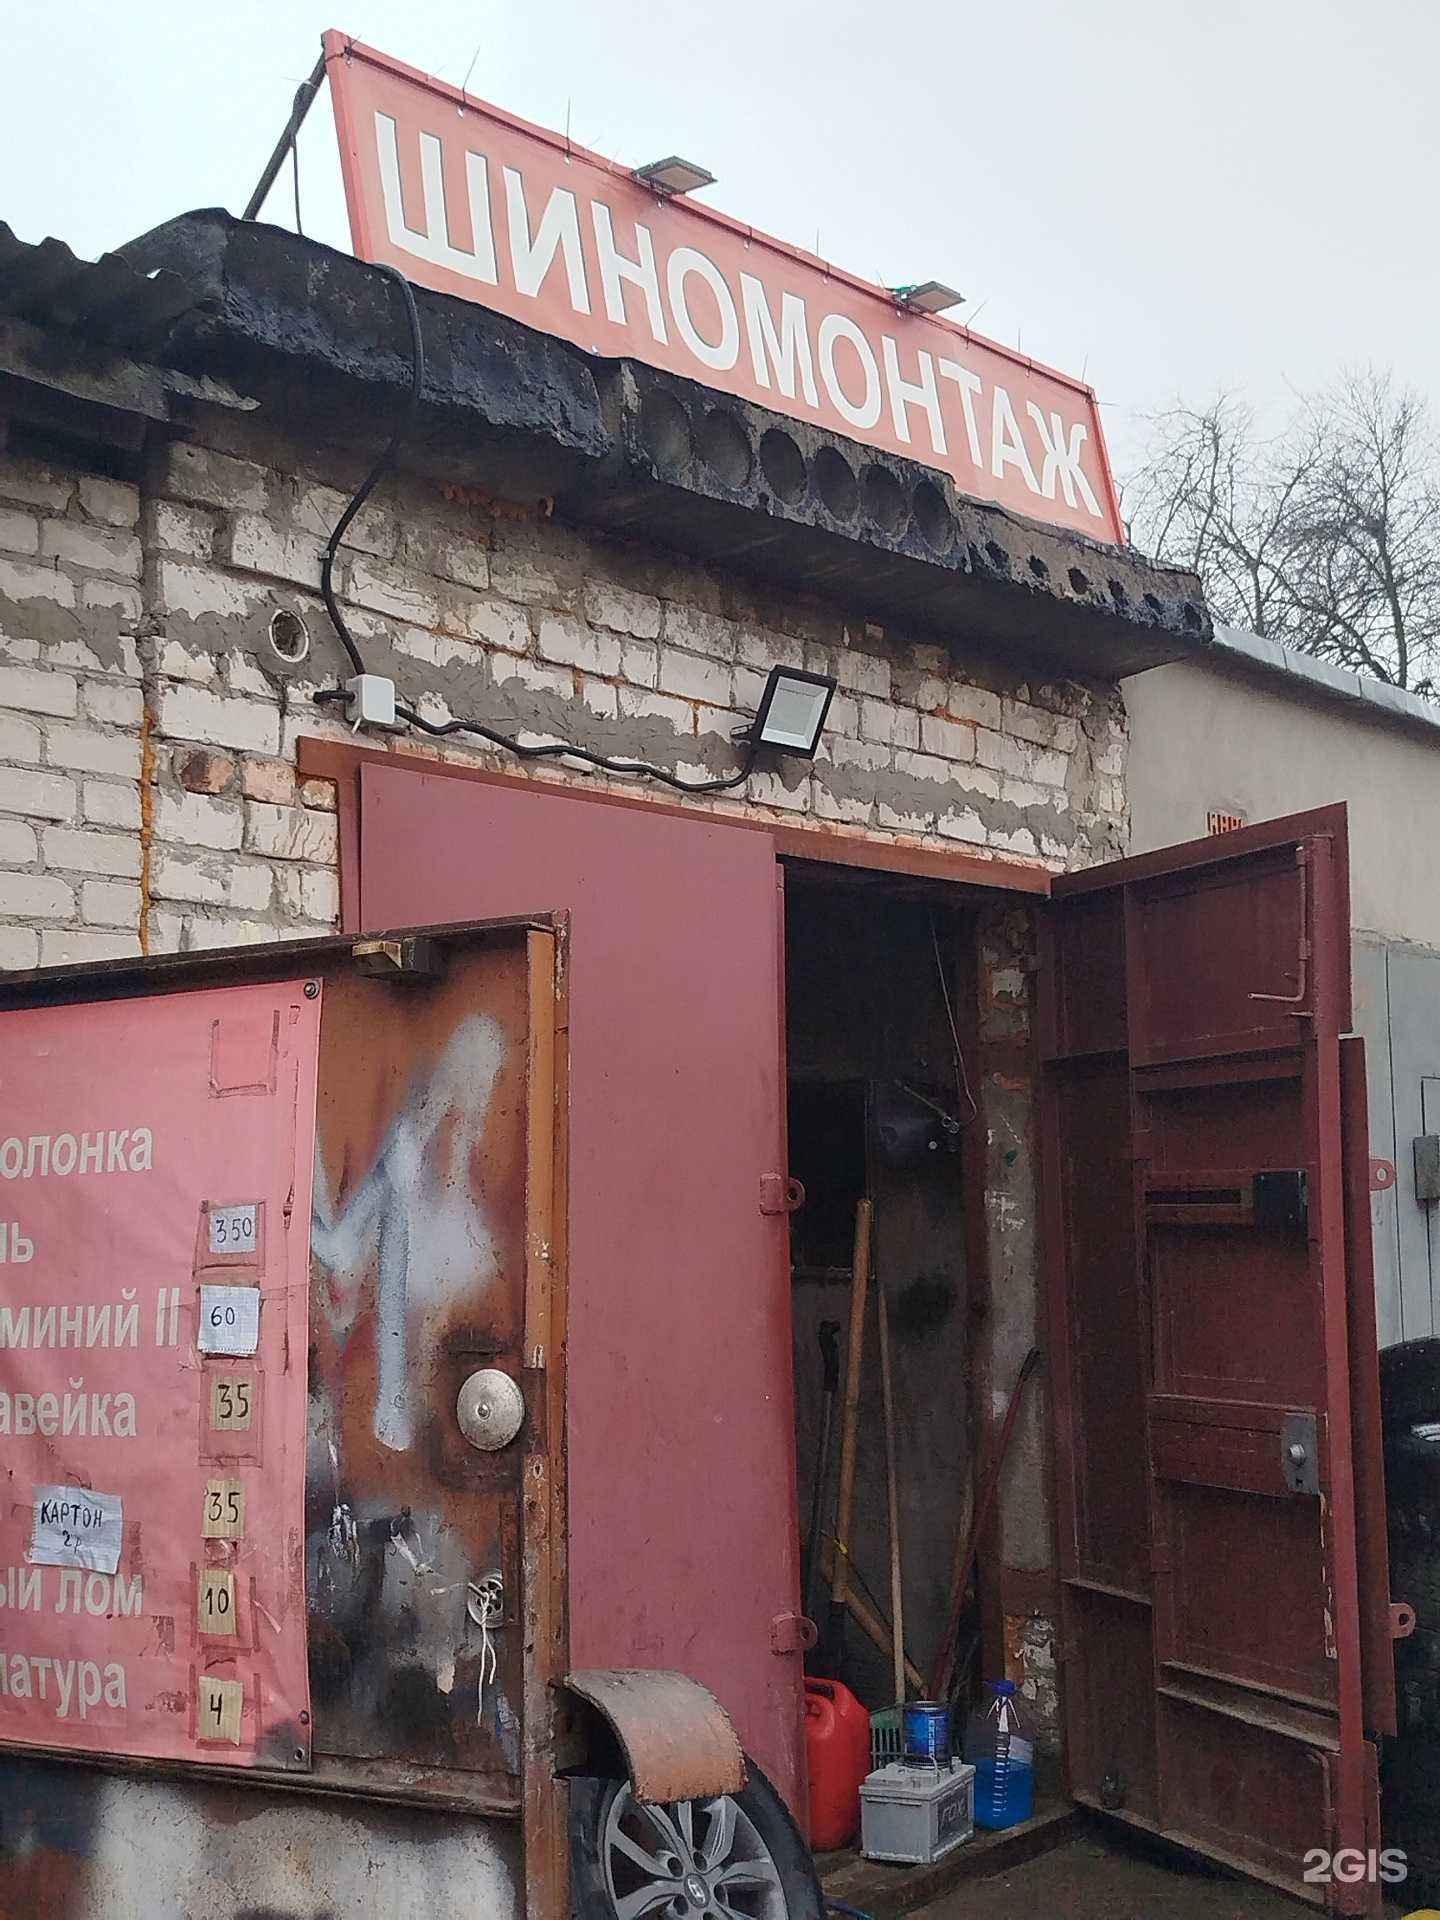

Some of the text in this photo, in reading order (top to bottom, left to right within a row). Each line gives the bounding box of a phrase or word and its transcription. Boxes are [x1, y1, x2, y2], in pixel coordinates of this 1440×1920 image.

[375, 111, 1104, 518] ШИНОМОНТАЖ
[0, 1126, 153, 1180] олонка
[215, 1217, 253, 1244] 350
[0, 1288, 139, 1348] миний
[211, 1306, 235, 1327] 60
[217, 1384, 249, 1420] 35
[41, 1499, 103, 1528] КАРТОН
[208, 1492, 239, 1524] 35
[55, 1569, 143, 1617] лом
[205, 1588, 229, 1615] 10
[209, 1693, 223, 1725] 4
